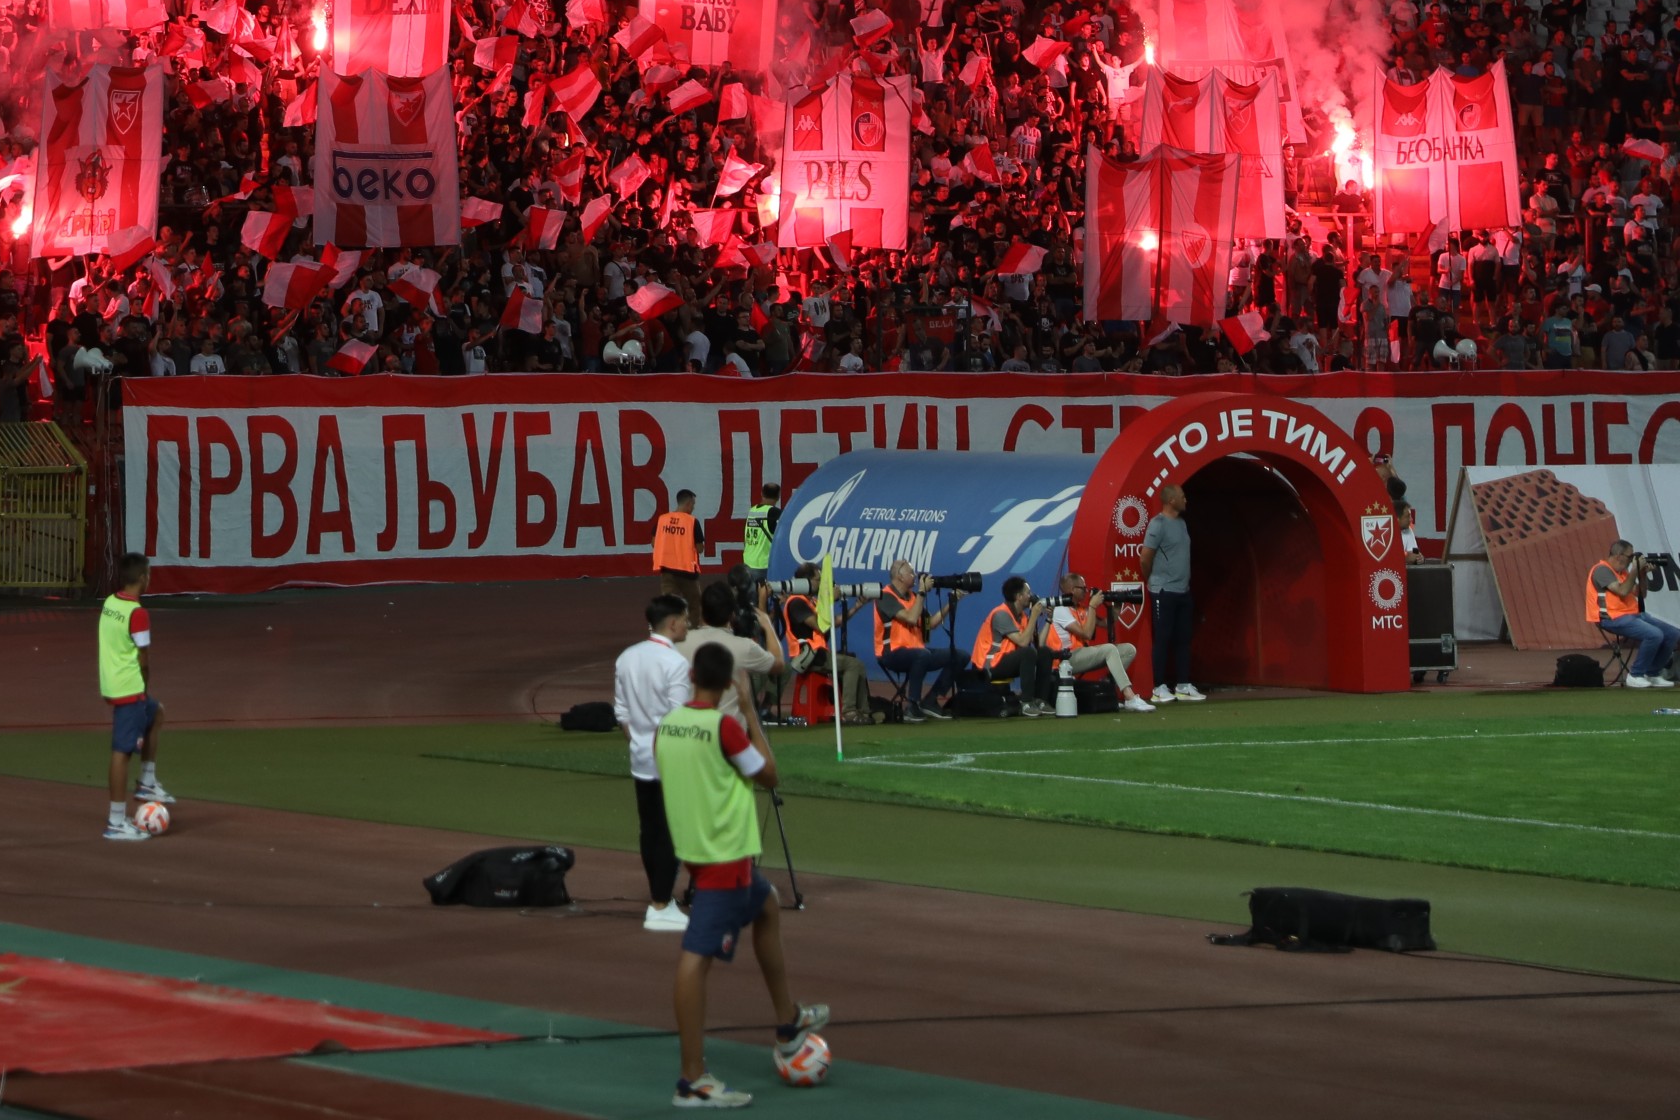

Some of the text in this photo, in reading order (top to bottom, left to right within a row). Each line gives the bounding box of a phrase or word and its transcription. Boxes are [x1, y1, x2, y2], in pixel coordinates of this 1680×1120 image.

[680, 5, 741, 34] BABY
[1395, 135, 1485, 165] БЕОБАНКА
[332, 150, 436, 200] beko
[804, 160, 872, 202] PILS
[1216, 408, 1254, 442] ЈЕ
[1261, 409, 1357, 485] ТИМ!
[145, 413, 356, 559] ПРВА
[376, 409, 670, 552] ЉУБАВ
[859, 507, 948, 523] PETROL STATIONS
[829, 526, 939, 573] GAZPROM
